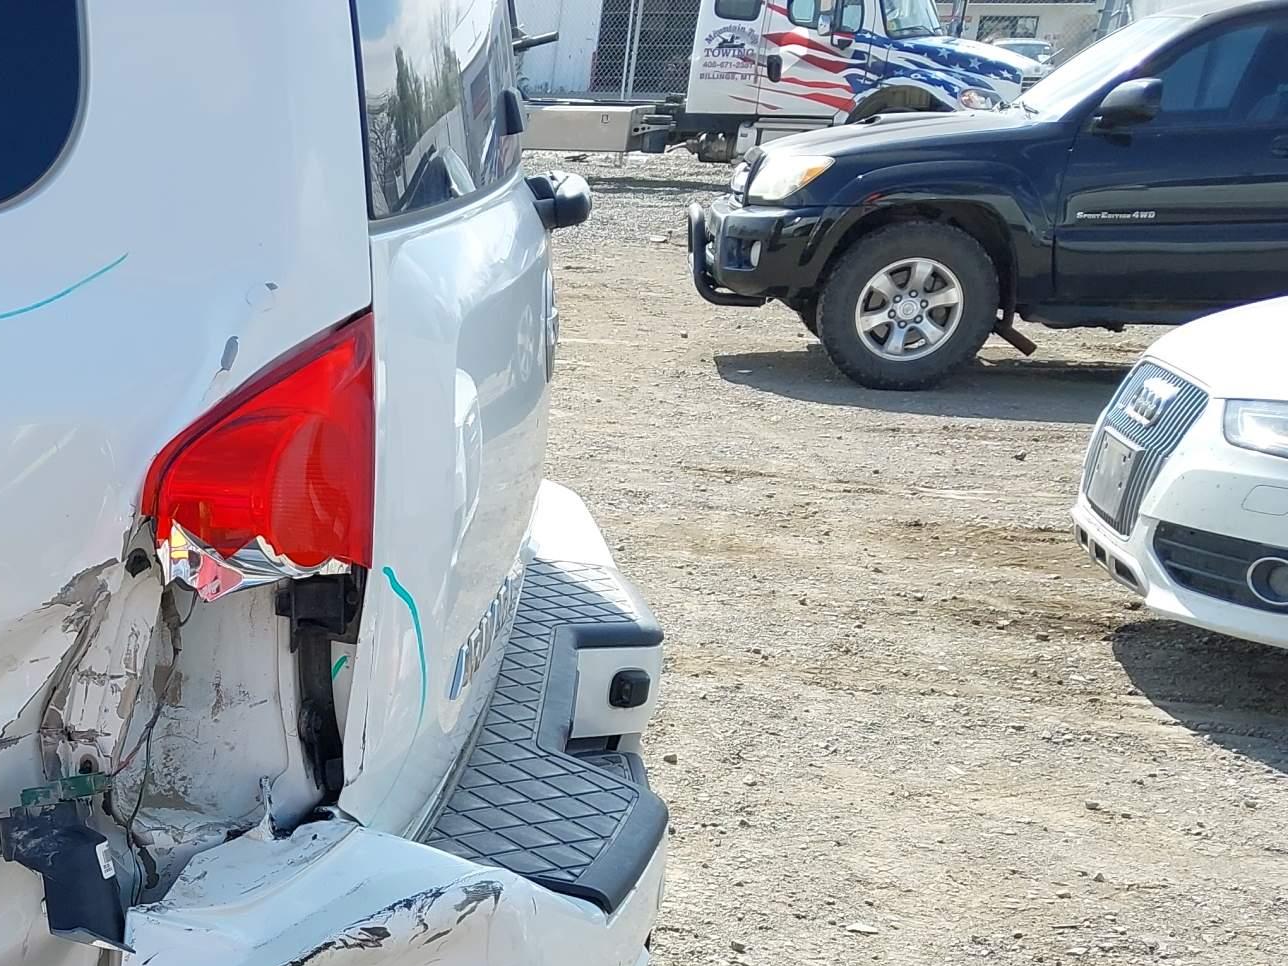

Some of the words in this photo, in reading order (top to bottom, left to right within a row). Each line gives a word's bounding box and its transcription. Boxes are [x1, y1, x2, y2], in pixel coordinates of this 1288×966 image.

[705, 24, 746, 45] Mountain
[703, 47, 754, 58] TOWING
[740, 73, 752, 81] MT
